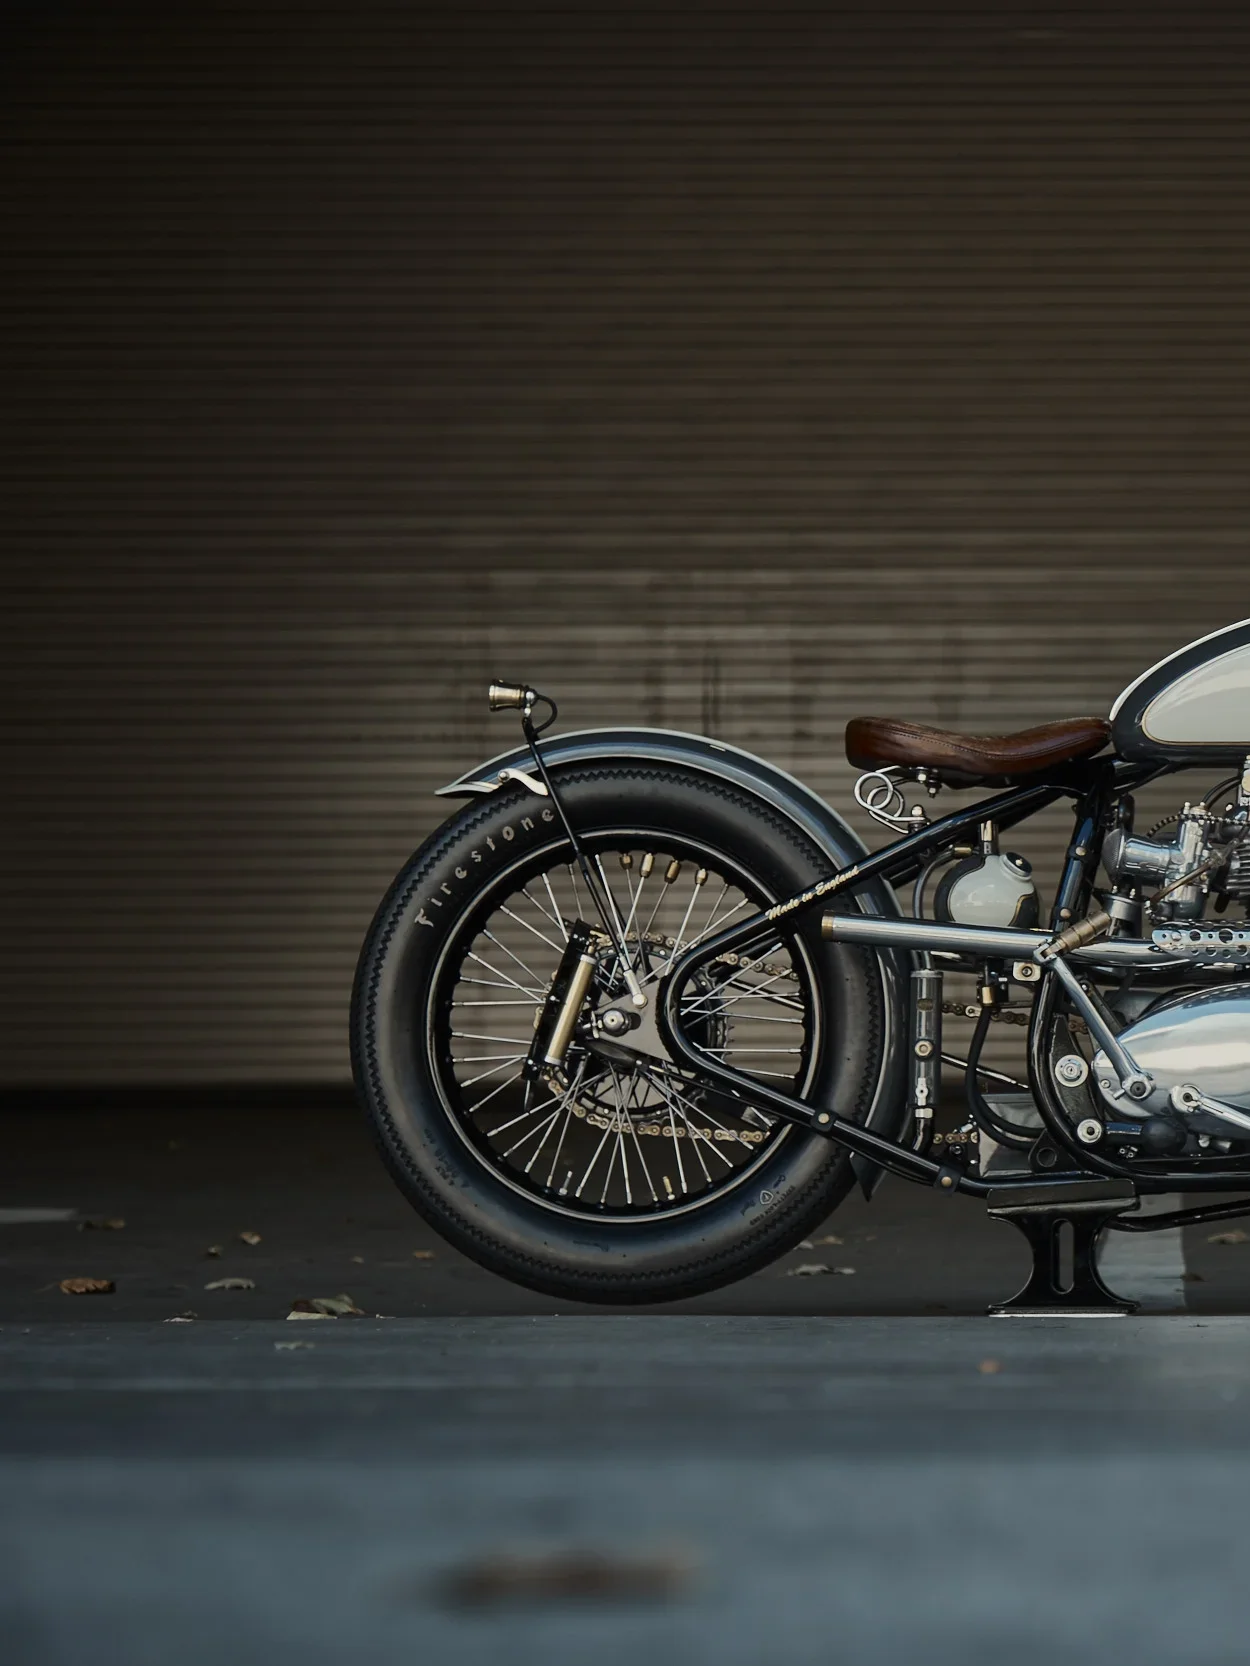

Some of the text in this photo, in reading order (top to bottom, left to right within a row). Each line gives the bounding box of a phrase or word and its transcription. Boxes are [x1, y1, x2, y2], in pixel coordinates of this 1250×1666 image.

[414, 809, 554, 928] Firestone
[764, 865, 859, 921] Made in England
